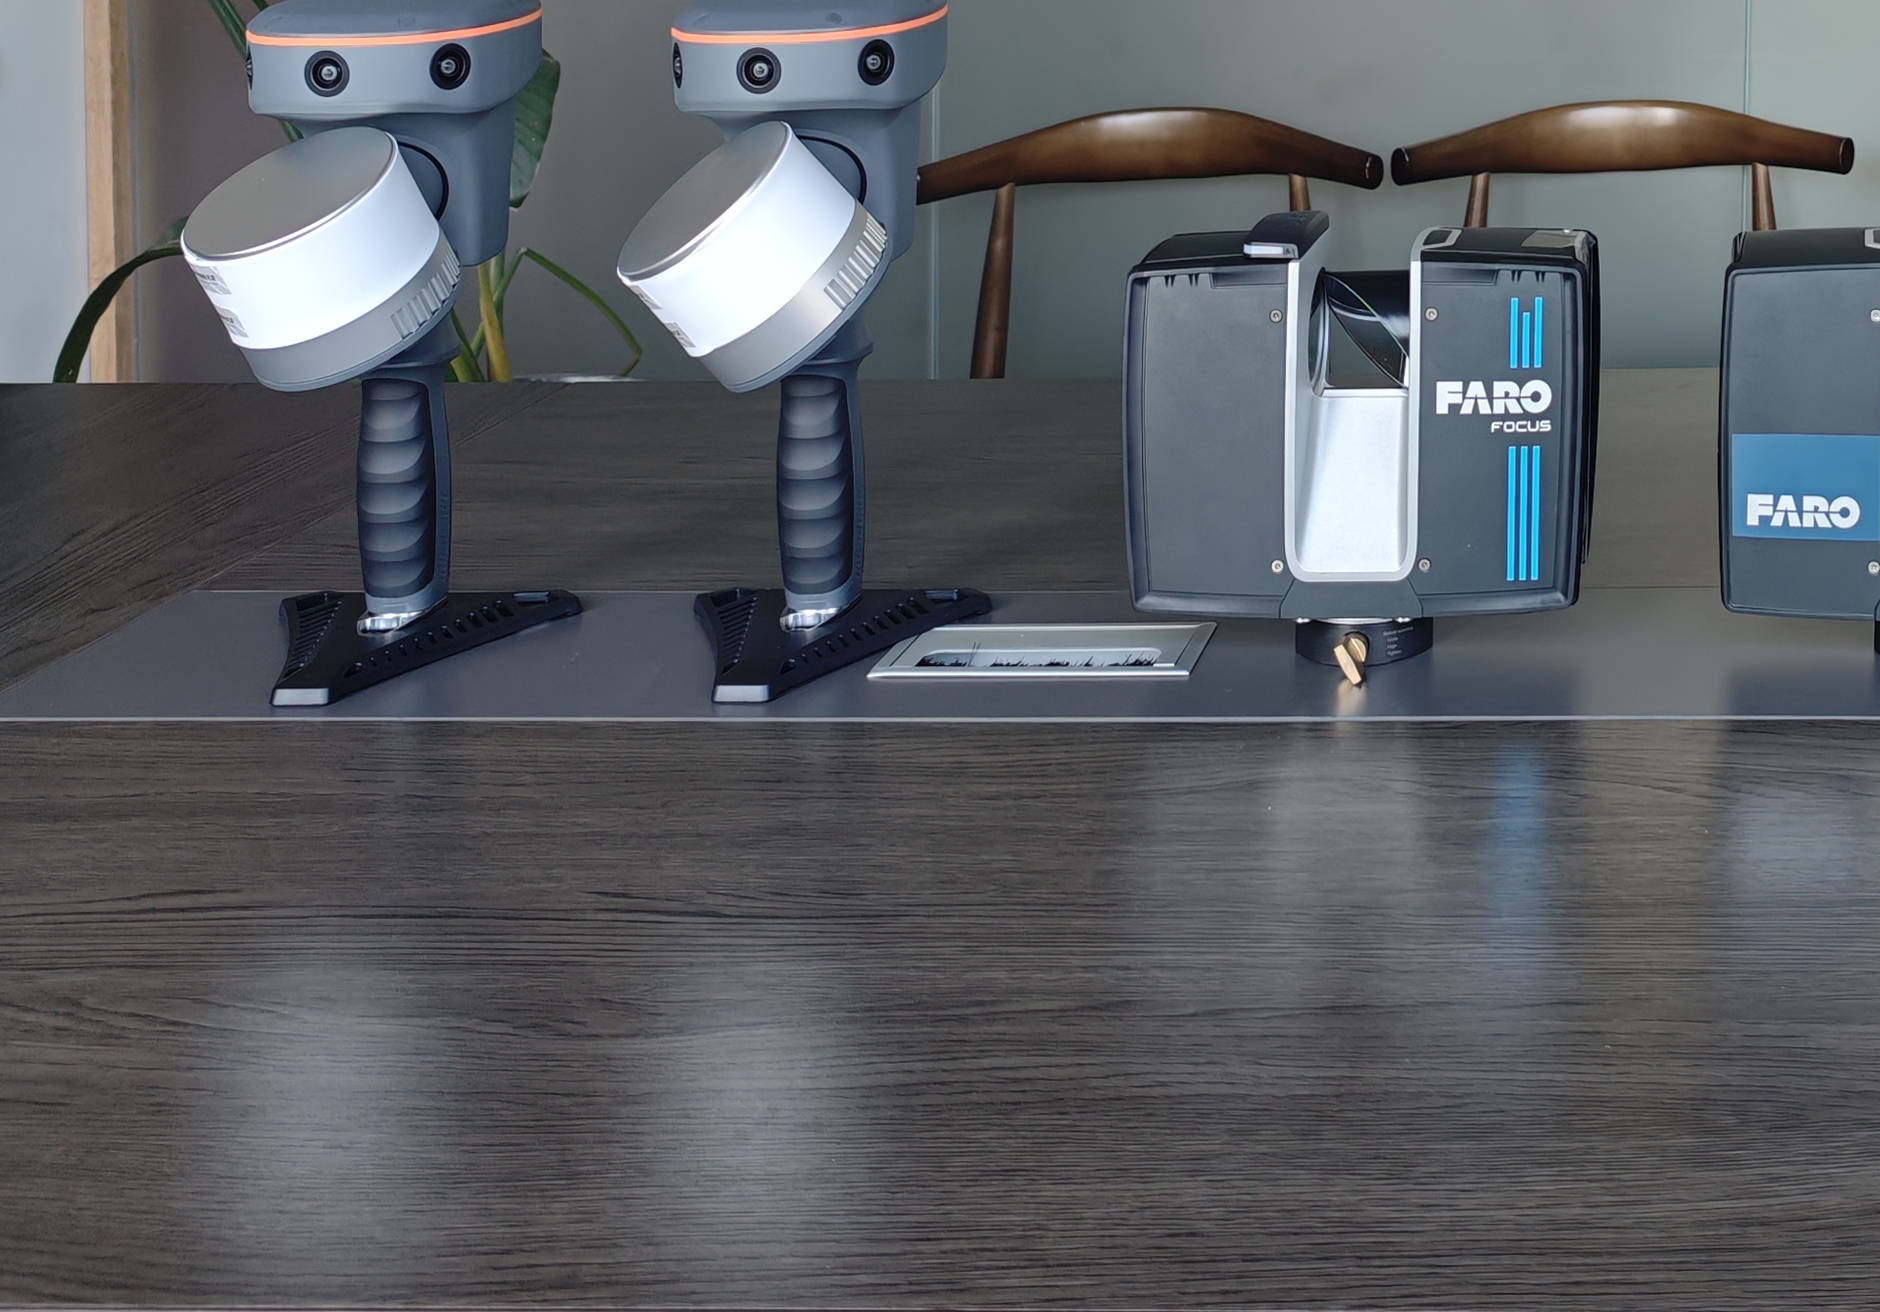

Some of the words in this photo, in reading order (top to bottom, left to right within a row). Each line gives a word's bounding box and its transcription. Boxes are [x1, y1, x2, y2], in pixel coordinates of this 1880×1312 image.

[1436, 379, 1552, 414] FARO
[1490, 420, 1552, 433] FOCUS
[1746, 493, 1861, 528] FARO
